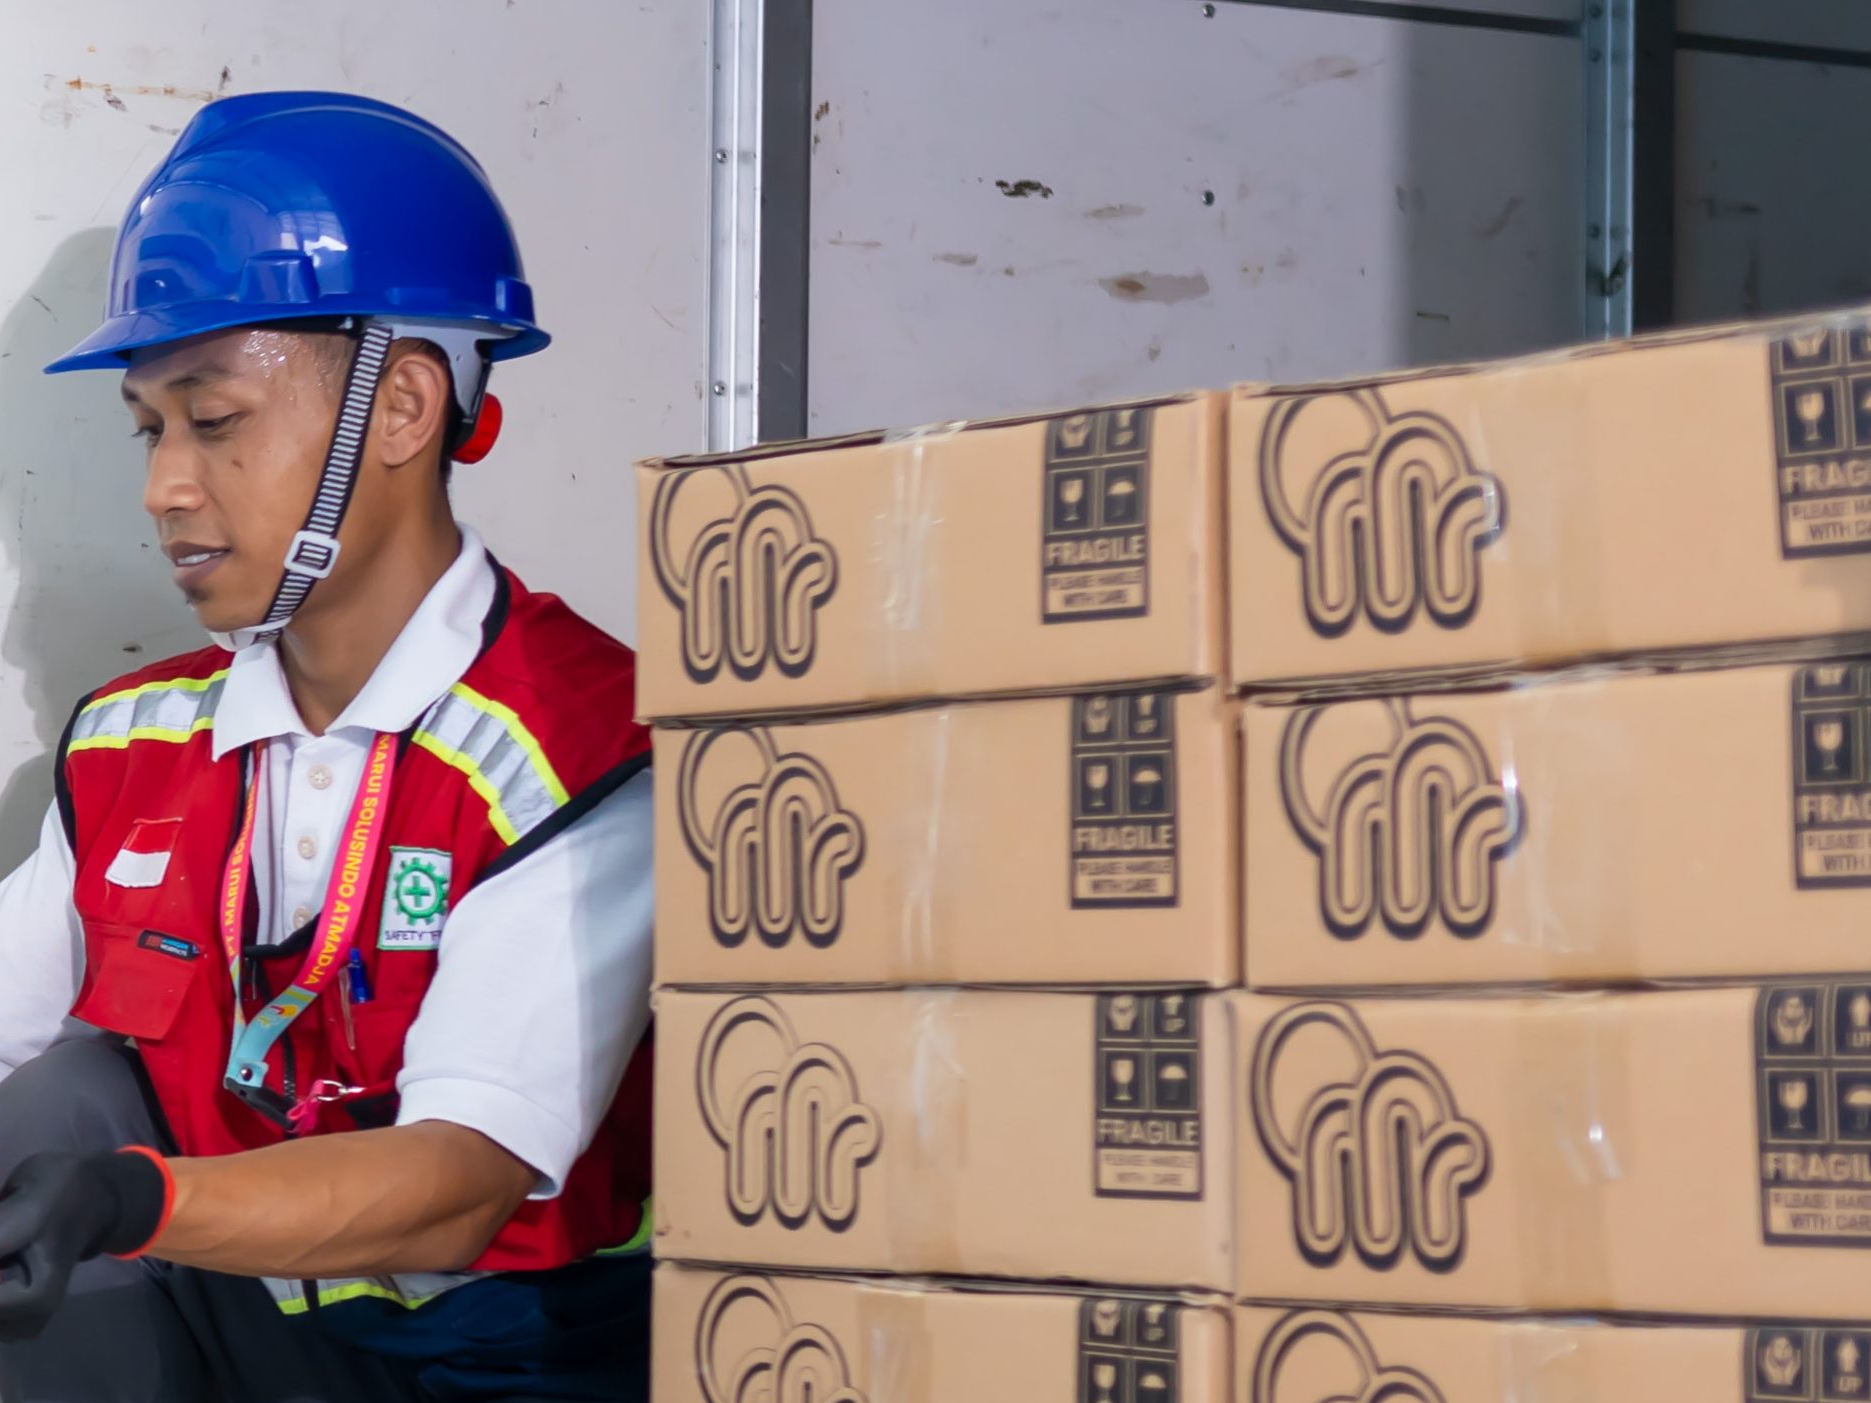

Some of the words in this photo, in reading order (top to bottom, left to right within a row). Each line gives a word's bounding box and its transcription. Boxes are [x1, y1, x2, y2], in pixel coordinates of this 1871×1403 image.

[1810, 522, 1851, 540] WITH
[1046, 534, 1145, 567] FRAGILE
[366, 734, 392, 794] MARUI
[337, 796, 380, 899] SOLUSINDO
[1075, 824, 1174, 851] FRAGILE
[224, 867, 241, 926] MARUI
[303, 899, 352, 985] ATMADJA
[384, 930, 423, 941] SAFETY
[1097, 1118, 1199, 1146] FRAGILE
[1790, 1213, 1829, 1229] WITH
